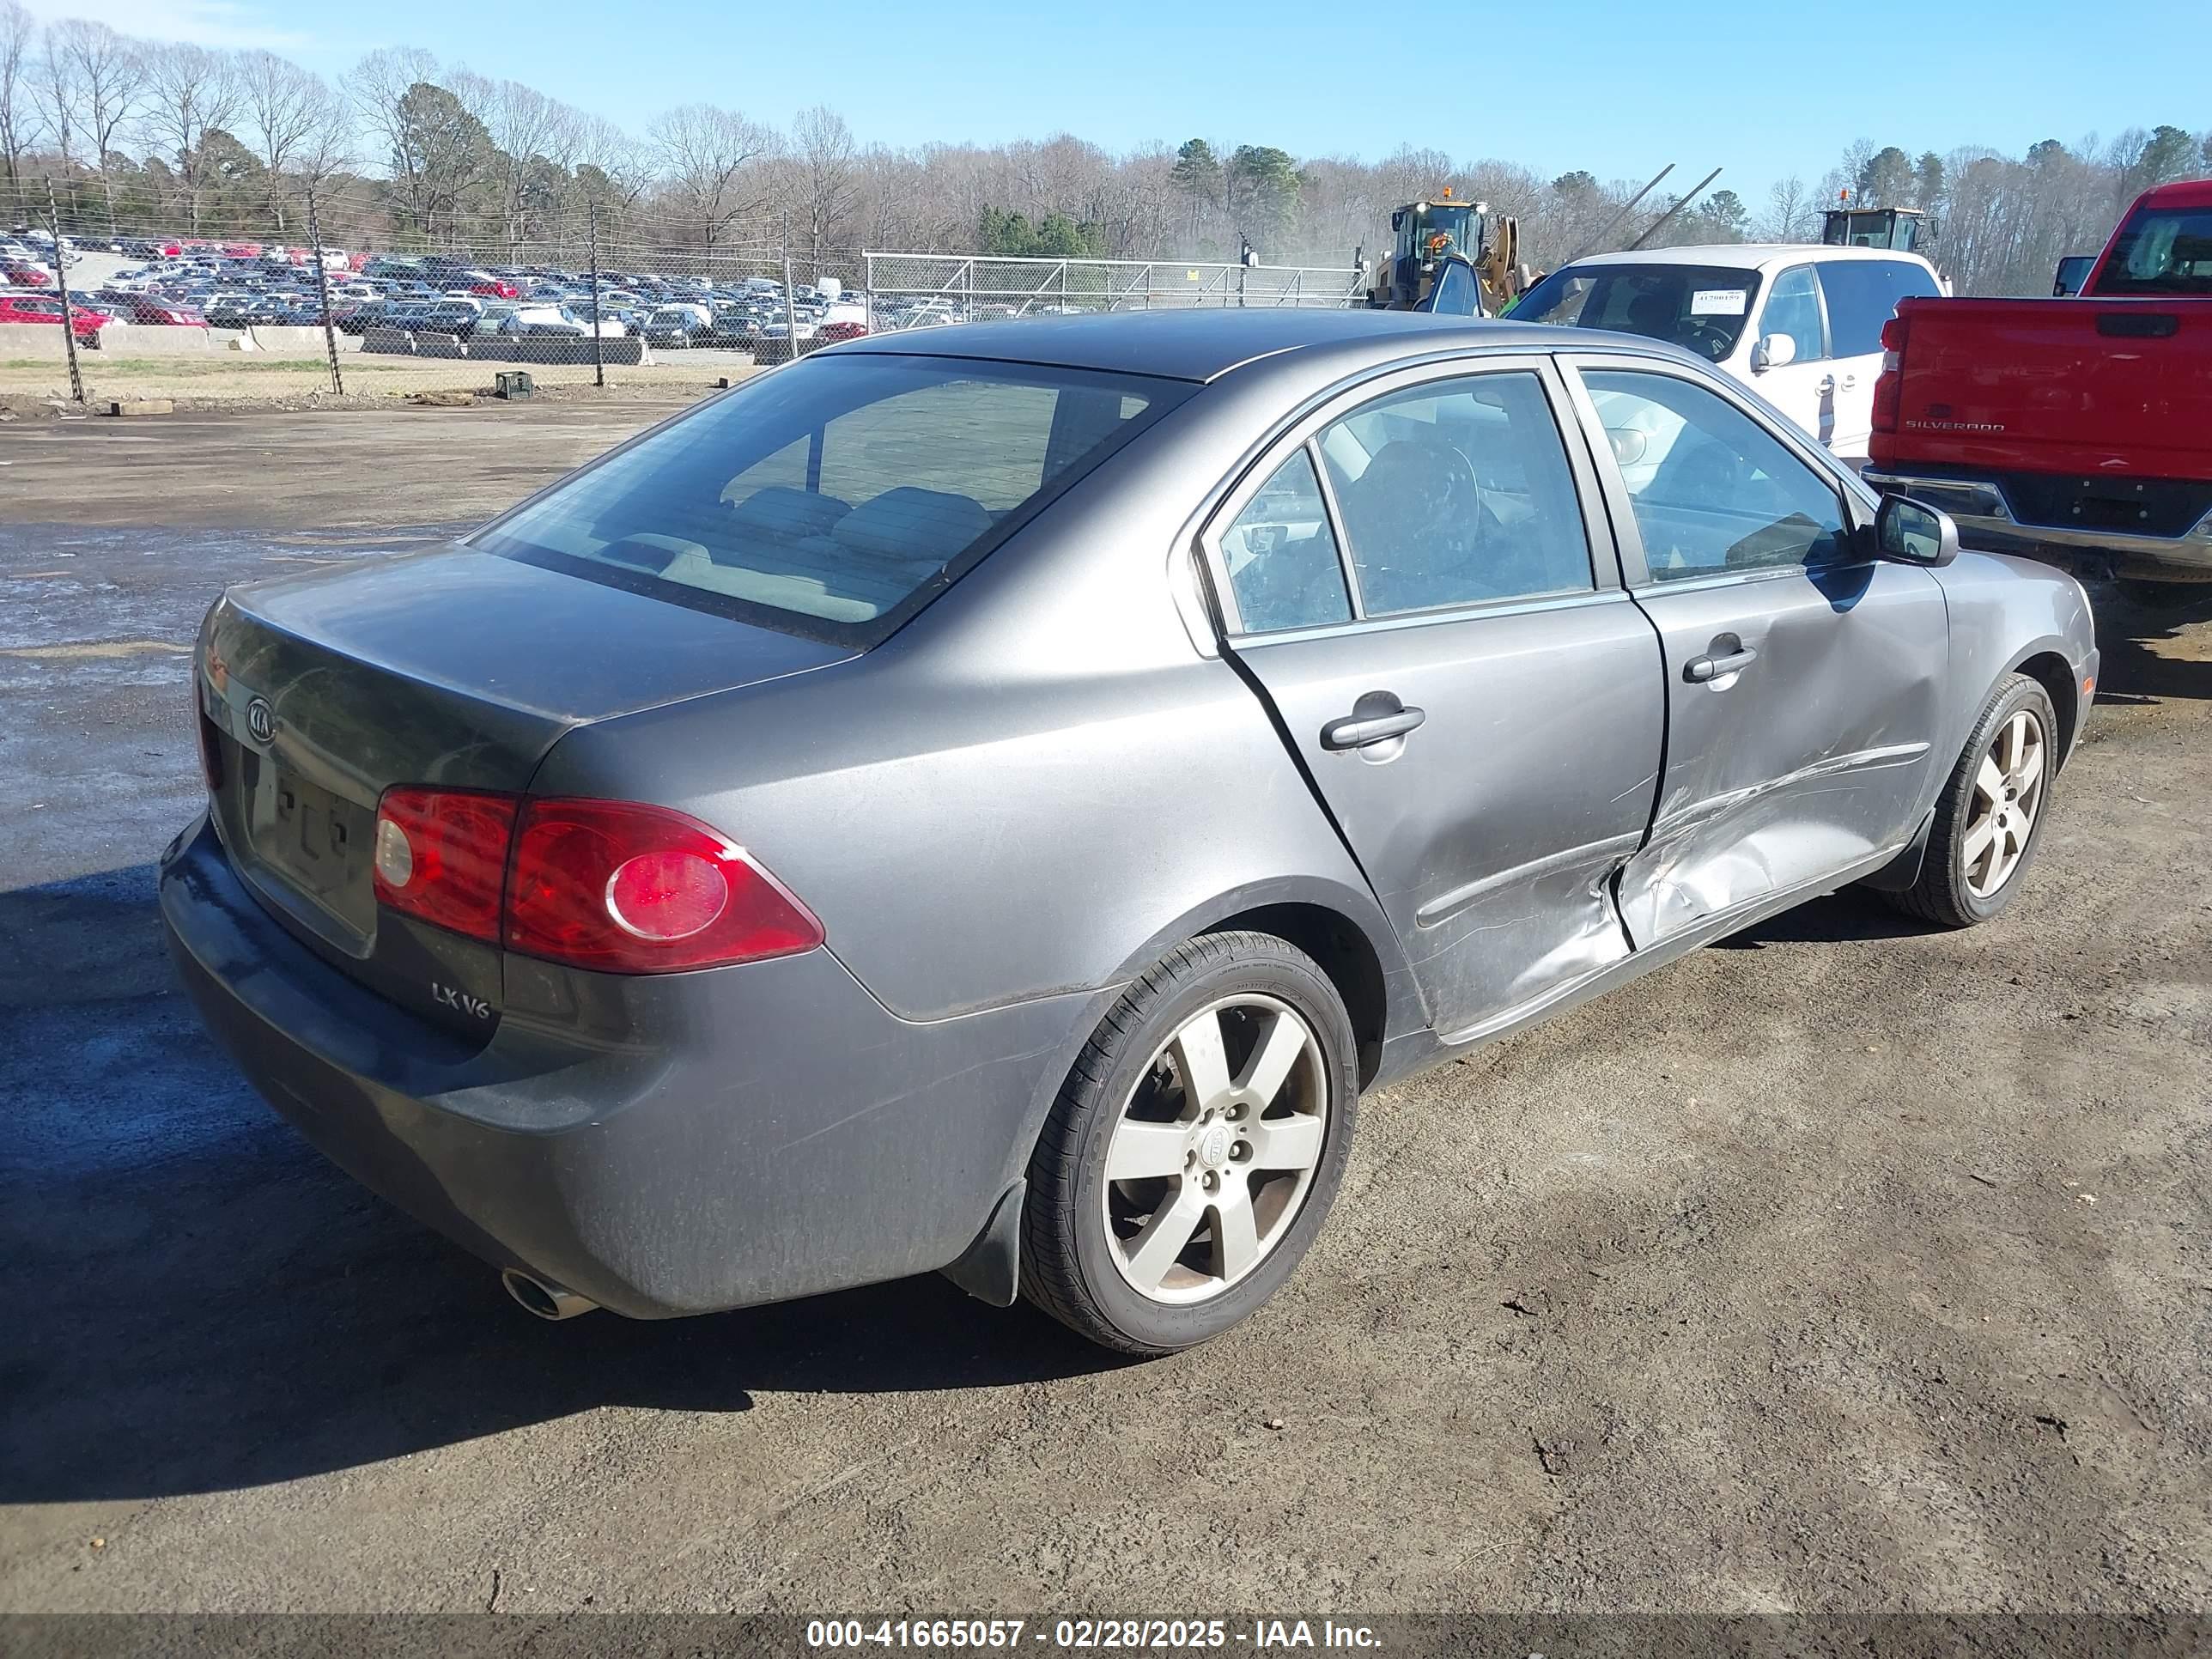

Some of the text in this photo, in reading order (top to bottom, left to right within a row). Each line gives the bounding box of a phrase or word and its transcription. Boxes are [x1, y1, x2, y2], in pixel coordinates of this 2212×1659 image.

[1905, 420, 2005, 432] SILVERADO
[249, 706, 270, 737] KIA
[432, 981, 489, 1019] LX V6
